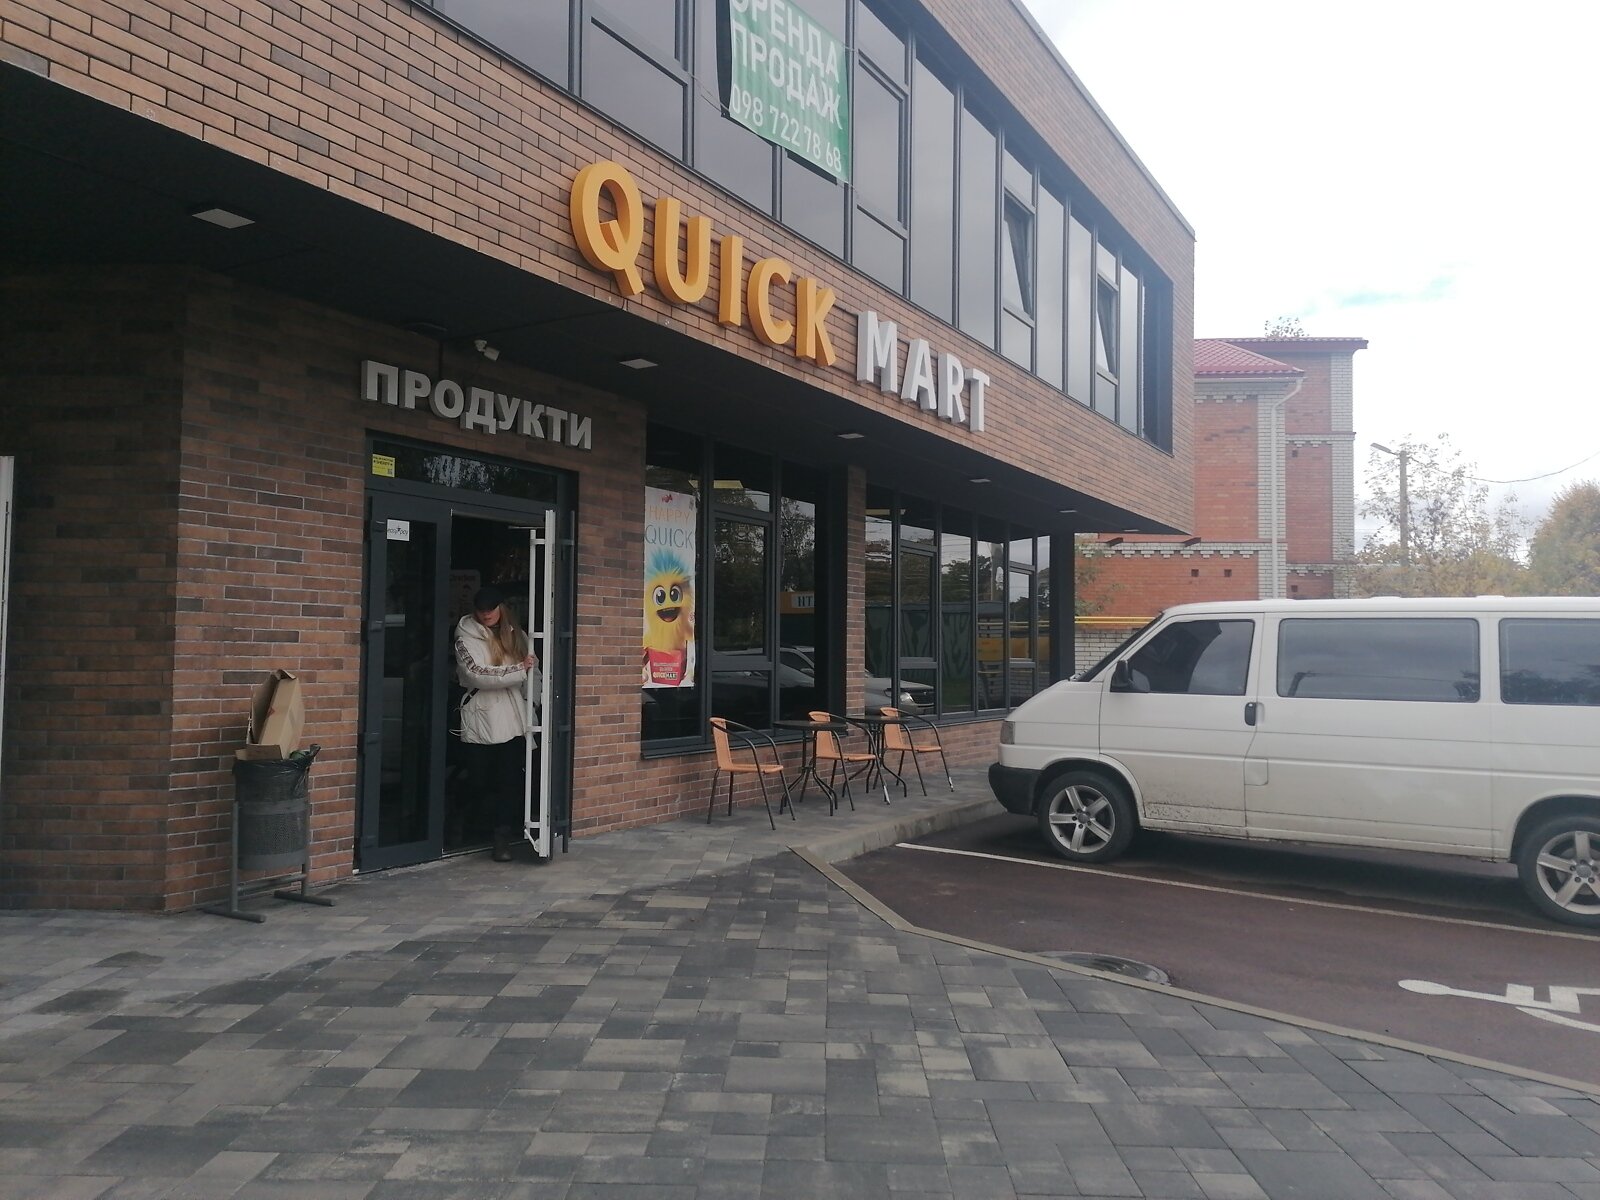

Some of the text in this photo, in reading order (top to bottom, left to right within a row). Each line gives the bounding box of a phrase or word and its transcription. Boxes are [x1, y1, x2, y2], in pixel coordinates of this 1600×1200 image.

[731, 0, 840, 84] РЕНДА
[732, 19, 843, 130] ПРОДАЖ
[731, 83, 842, 173] 098 722 78 68
[570, 160, 990, 433] QUICK MART
[361, 359, 593, 450] ПРОДУКТИ
[645, 524, 694, 551] QUICK
[649, 505, 691, 527] HAPPY
